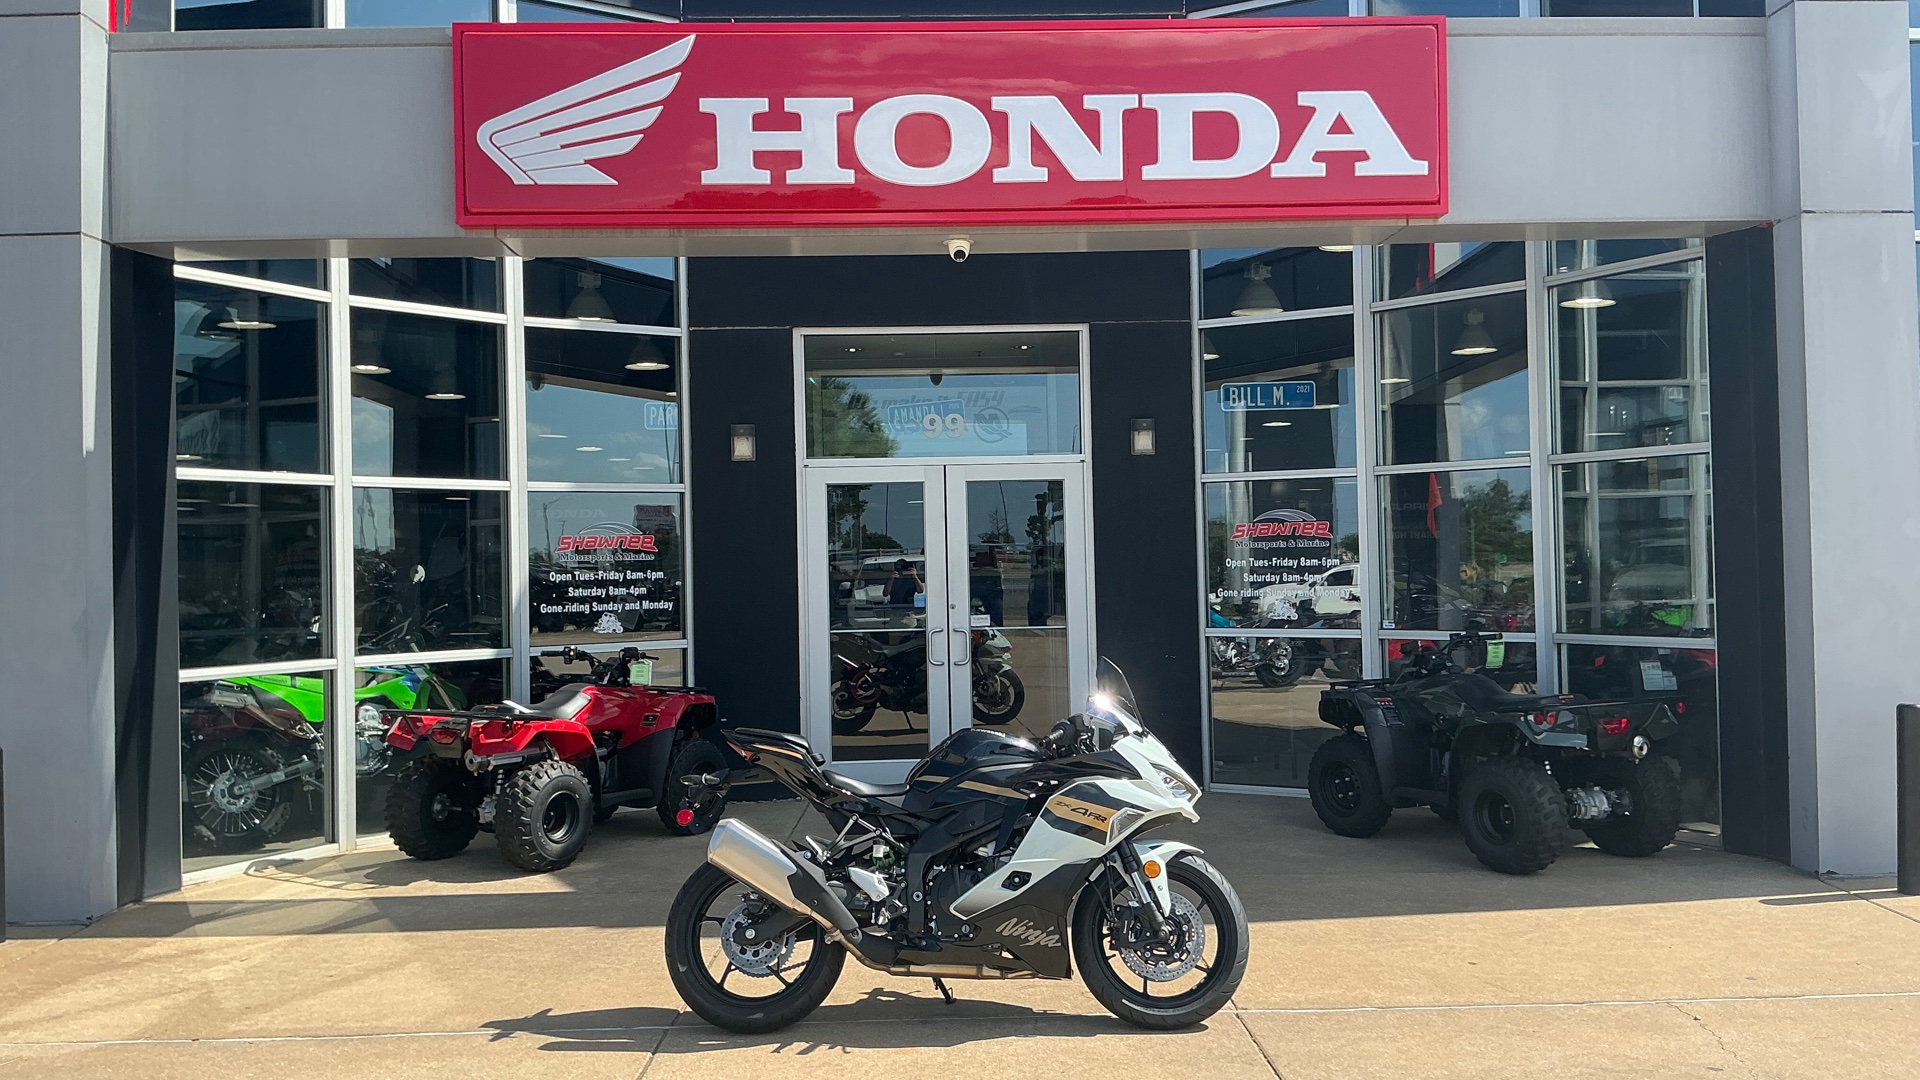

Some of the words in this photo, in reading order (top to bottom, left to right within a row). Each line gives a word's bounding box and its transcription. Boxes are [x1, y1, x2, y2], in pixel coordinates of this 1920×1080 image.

[698, 90, 1429, 187] HONDA
[1296, 385, 1310, 393] 2021
[1229, 386, 1266, 407] BILL
[1273, 386, 1290, 406] M.
[893, 405, 936, 425] AMANDA
[923, 413, 965, 439] 99
[1235, 539, 1287, 550] Motorsports
[1288, 539, 1296, 548] &
[1297, 539, 1330, 548] Marine
[560, 552, 614, 563] Motorsports
[614, 552, 622, 561] &
[623, 552, 655, 561] Marine
[1225, 558, 1247, 570] Open
[1249, 557, 1298, 568] Tues-Friday
[1300, 557, 1340, 567] 8am-6pm
[549, 572, 572, 583] Open
[574, 570, 624, 582] Tues-Friday
[626, 570, 664, 580] 8am-6pm
[1243, 573, 1281, 584] Saturday
[1282, 572, 1322, 583] 8am-4pm
[568, 586, 606, 598] Saturday
[609, 586, 647, 597] 8am-4pm
[1217, 588, 1238, 598] Gone
[1241, 587, 1264, 599] riding
[1266, 587, 1298, 599] Sunday
[1299, 588, 1314, 597] and
[1318, 587, 1351, 599] Monday
[540, 604, 563, 613] Gone
[565, 603, 590, 614] riding
[592, 602, 623, 613] Sunday
[624, 601, 640, 611] and
[642, 600, 673, 611] Monday
[995, 917, 1061, 947] Ninja
